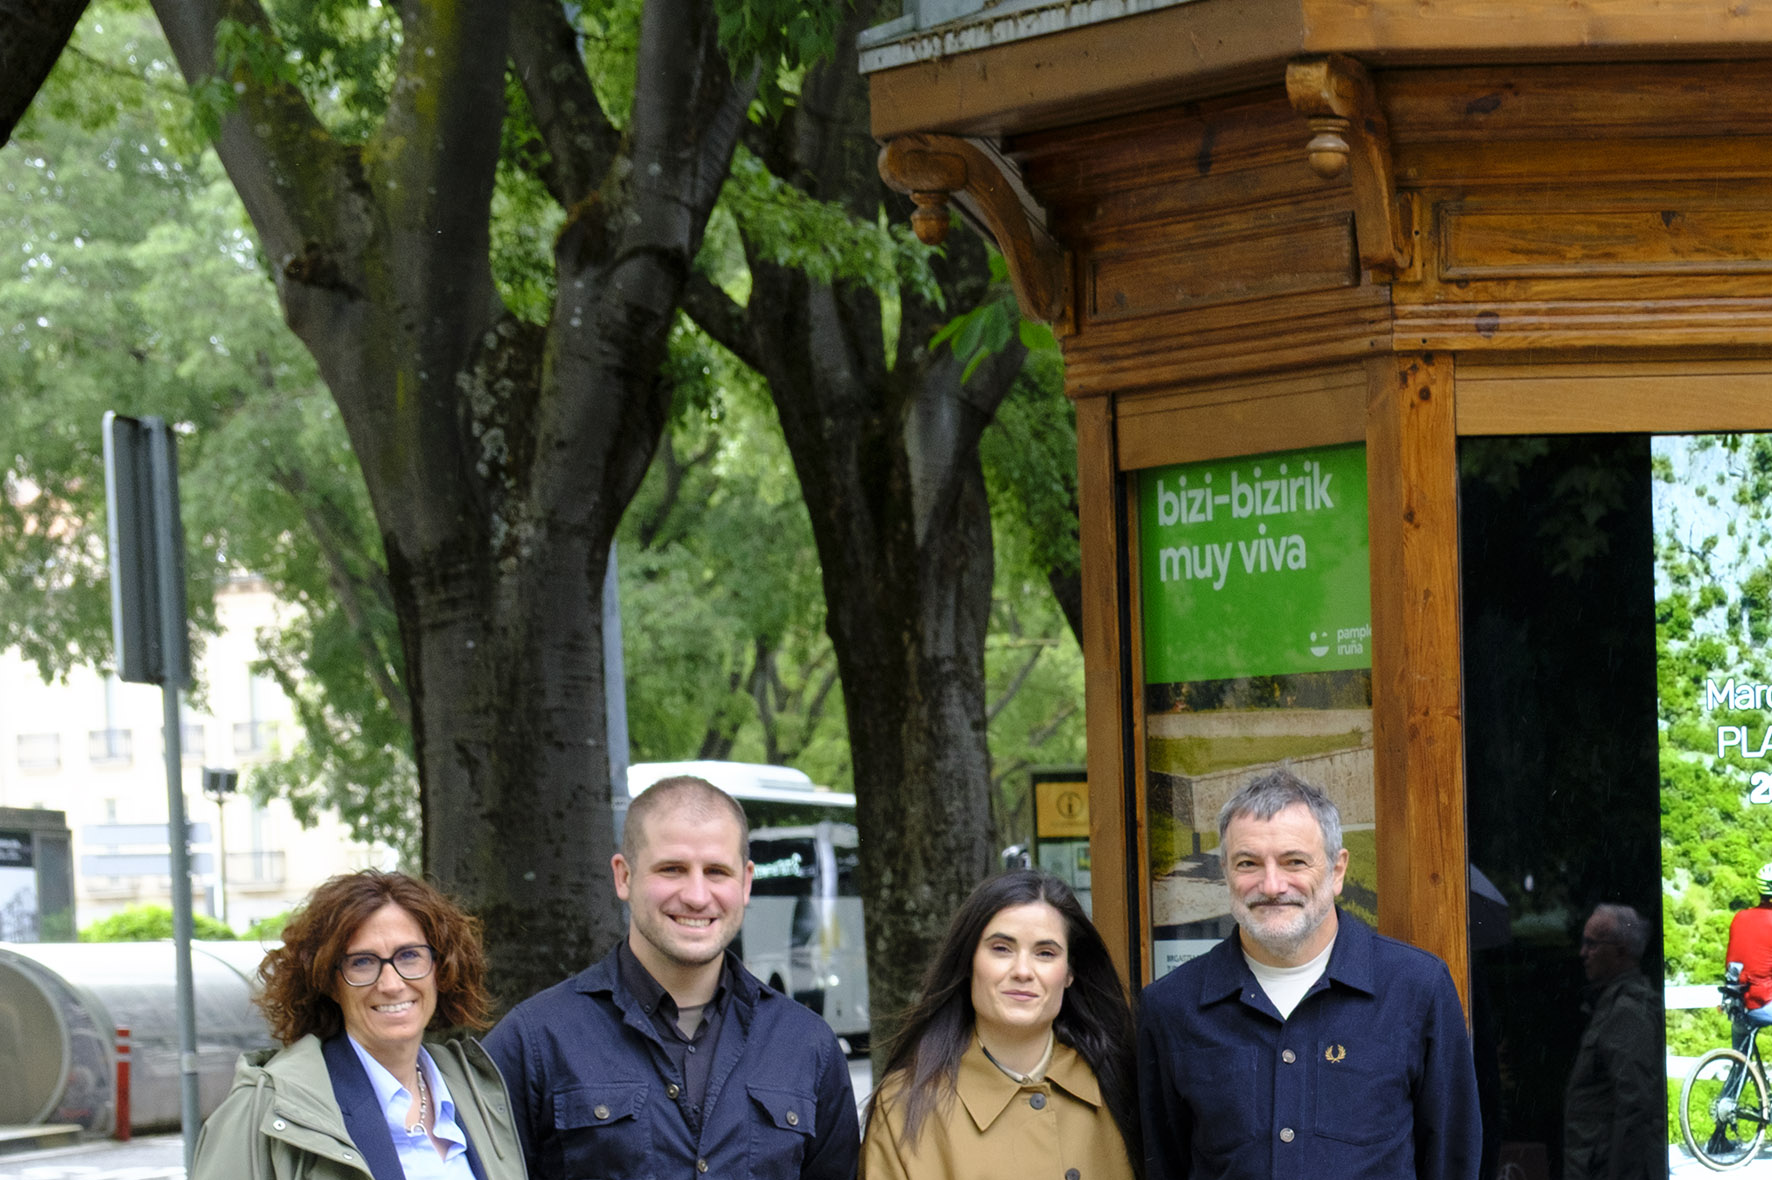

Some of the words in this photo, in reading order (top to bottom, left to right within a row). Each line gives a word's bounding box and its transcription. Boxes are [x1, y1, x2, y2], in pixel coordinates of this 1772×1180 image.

[1157, 460, 1334, 526] bizi-bizirik
[1160, 542, 1233, 591] muy
[1238, 523, 1307, 574] viva
[1337, 640, 1363, 656] iruña
